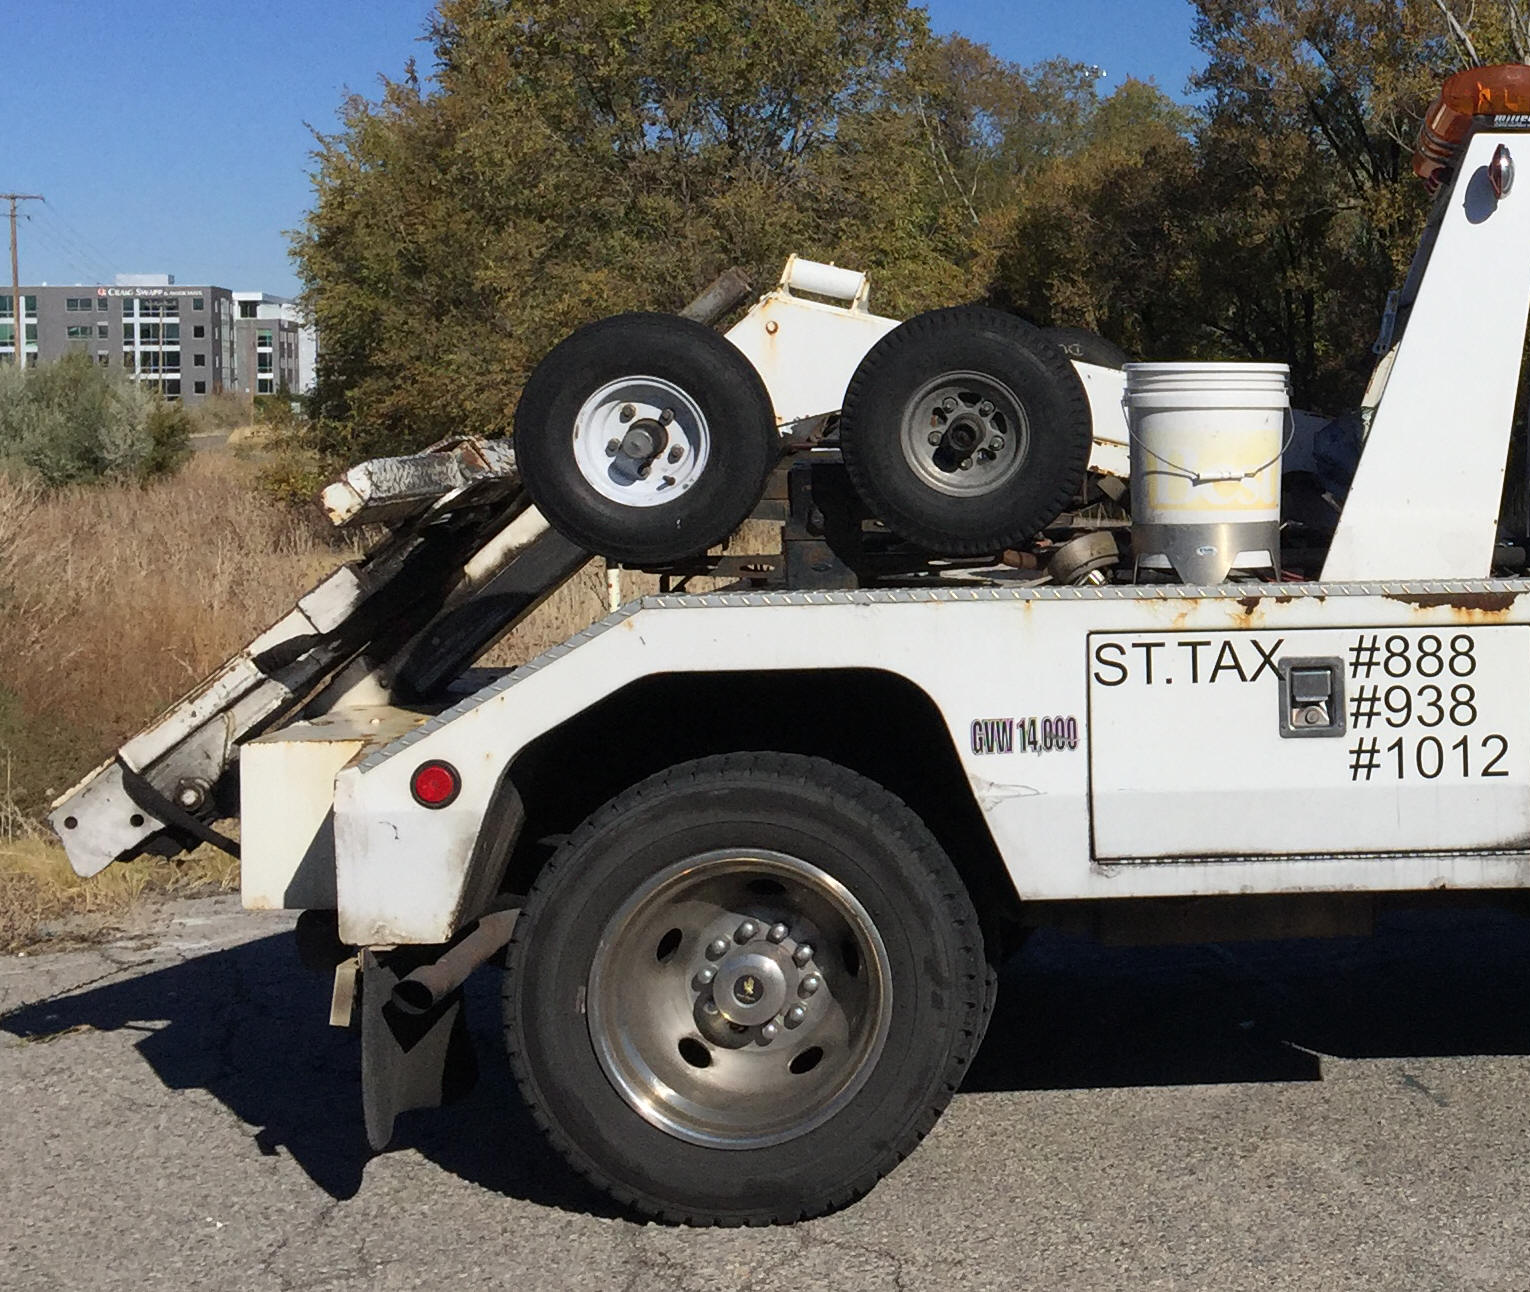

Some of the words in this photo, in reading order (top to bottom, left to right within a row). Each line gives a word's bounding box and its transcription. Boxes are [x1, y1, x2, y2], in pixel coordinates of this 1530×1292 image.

[1349, 634, 1477, 679] #888
[1349, 684, 1478, 729] #938
[971, 718, 1014, 755] GVW
[1349, 735, 1510, 781] #1012
